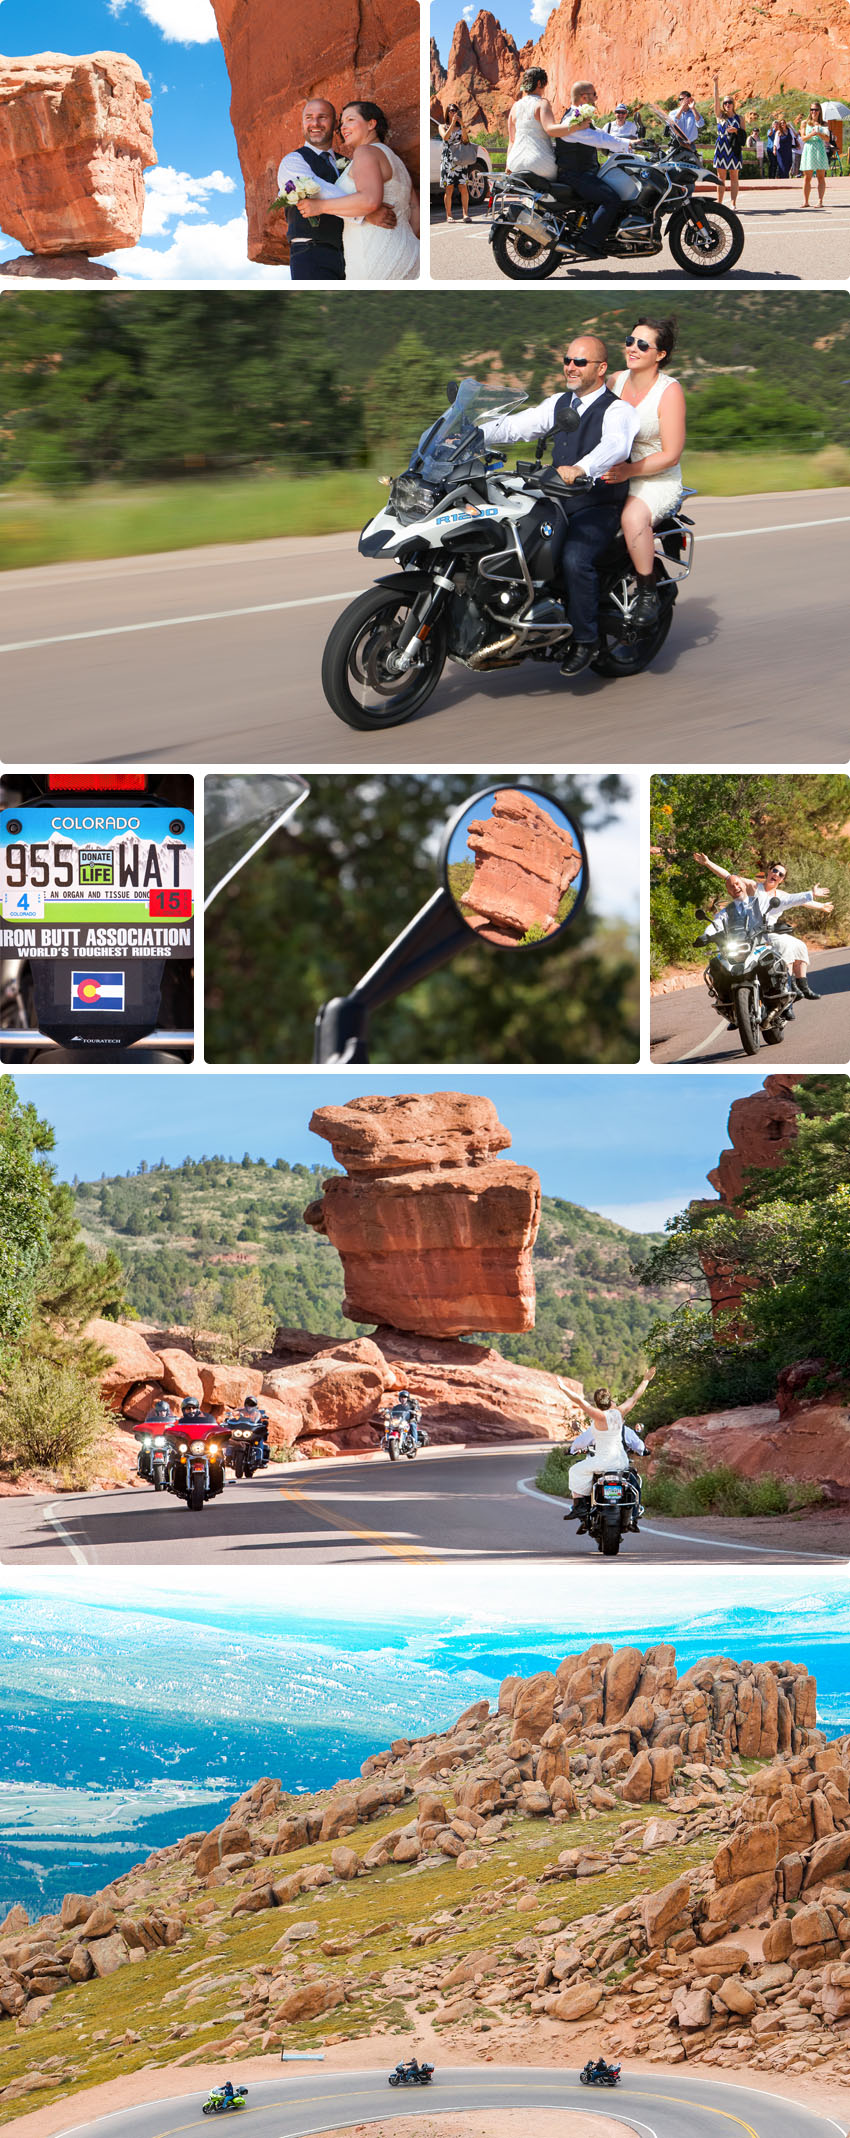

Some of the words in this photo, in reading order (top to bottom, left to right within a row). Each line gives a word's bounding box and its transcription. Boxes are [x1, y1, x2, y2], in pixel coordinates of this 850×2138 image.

[51, 816, 140, 830] COLORADO
[82, 853, 111, 861] DONATE
[6, 844, 73, 887] 955
[119, 844, 186, 887] WAT
[82, 868, 111, 882] LIFE
[16, 893, 30, 911] 4
[156, 891, 180, 910] 15
[0, 928, 36, 947] IRON
[41, 928, 81, 947] BUTT
[85, 927, 191, 947] ASSOCIATION
[17, 947, 69, 958] WORLD'S
[73, 947, 129, 957] TOUGHEST
[132, 947, 172, 957] RIDERS
